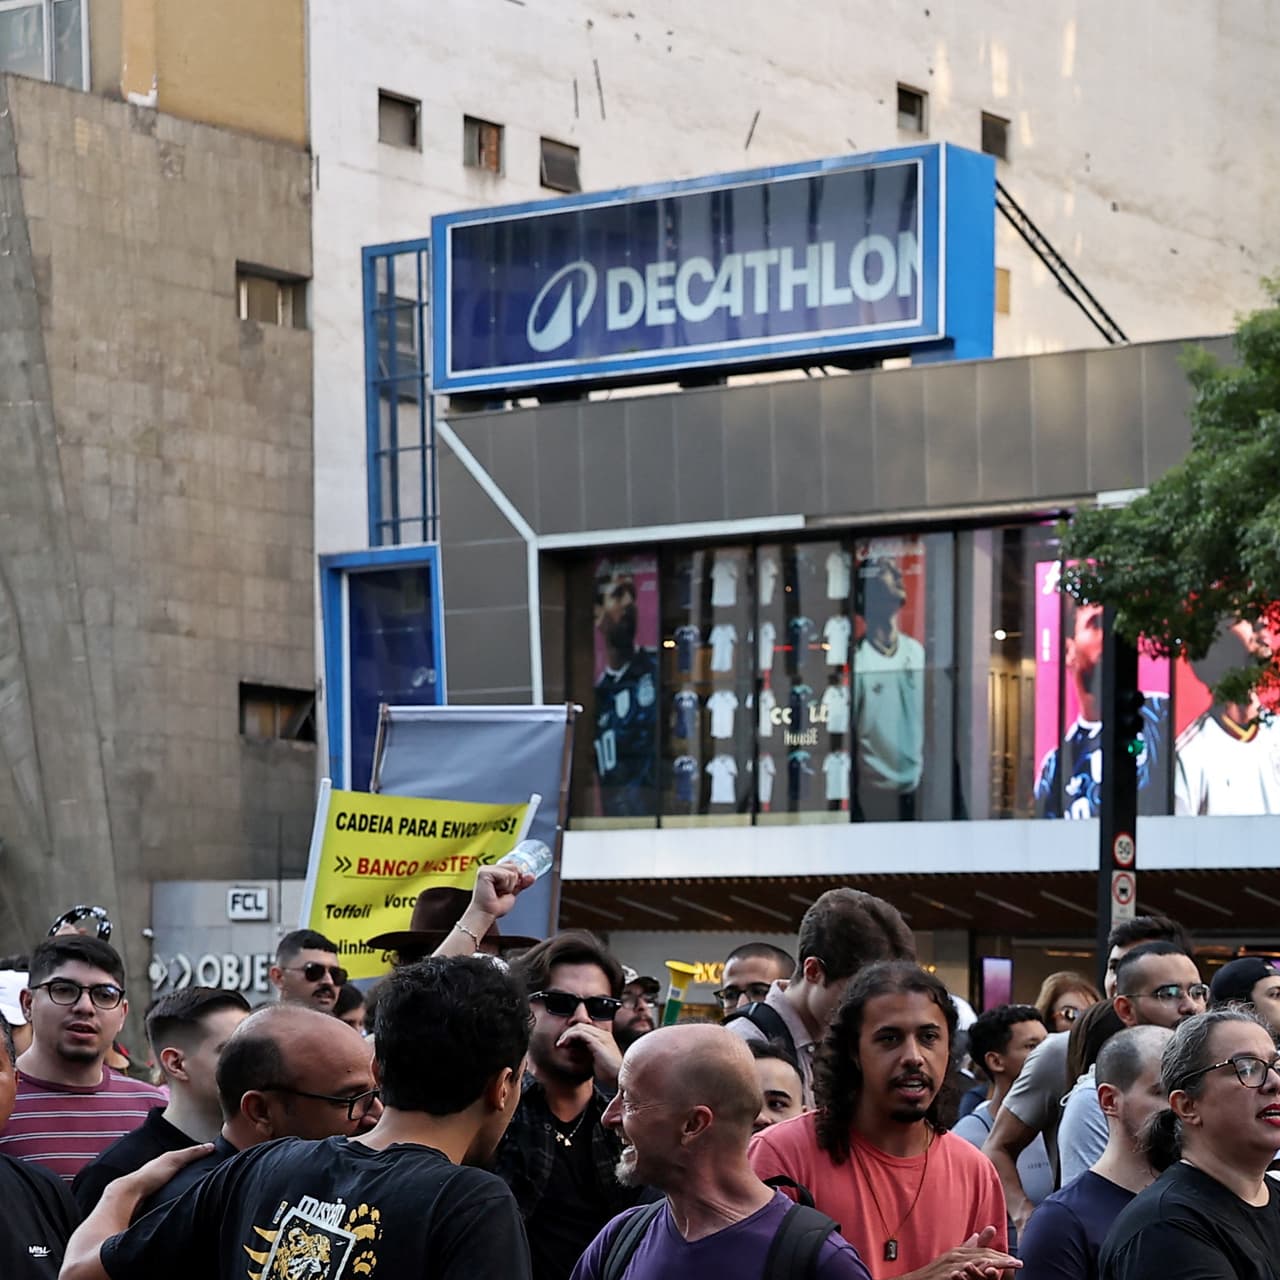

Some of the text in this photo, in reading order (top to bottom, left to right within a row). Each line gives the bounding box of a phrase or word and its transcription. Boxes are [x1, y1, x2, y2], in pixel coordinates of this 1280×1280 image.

[336, 812, 393, 834] CADEIA
[400, 818, 437, 838] PARA
[357, 857, 418, 877] BANCO
[231, 893, 263, 911] FCL
[385, 894, 416, 908] Vorc
[326, 904, 372, 919] Toffoli
[198, 953, 276, 992] OBJE
